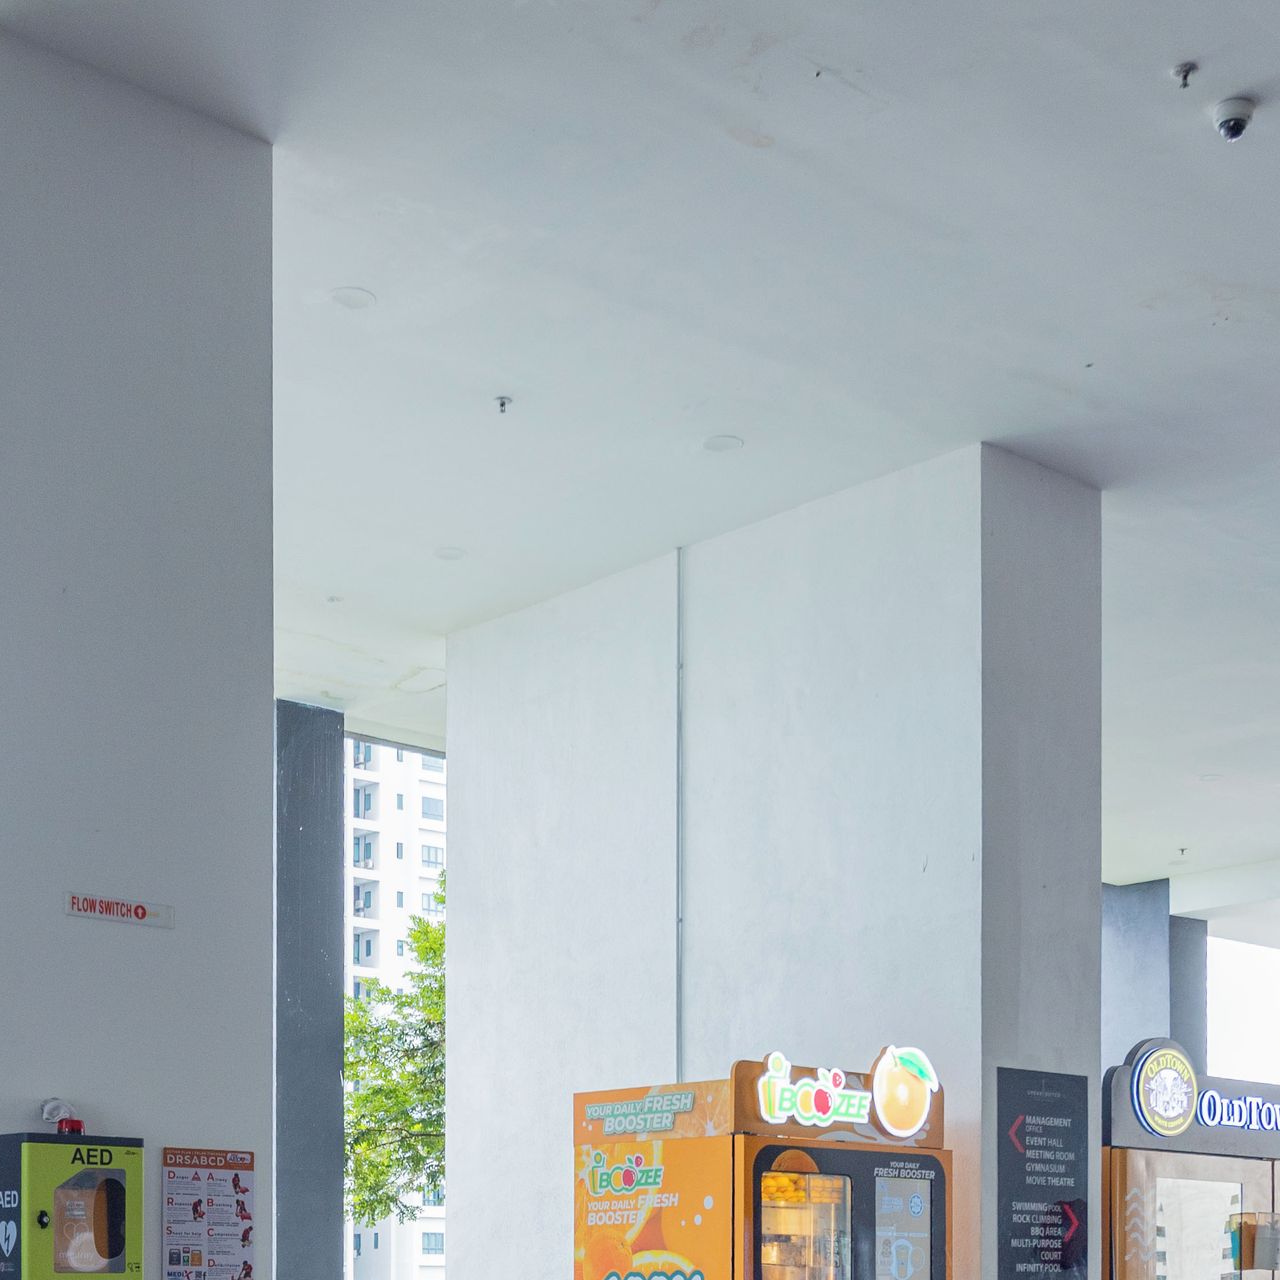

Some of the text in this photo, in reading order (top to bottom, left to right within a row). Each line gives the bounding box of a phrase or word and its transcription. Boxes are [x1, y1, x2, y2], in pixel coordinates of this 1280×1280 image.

[71, 896, 132, 918] FLOW SWITCH
[586, 1093, 694, 1117] YOUR DAILY FRESH
[605, 1113, 673, 1133] BOOSTER
[1025, 1115, 1072, 1127] MANAGEMENT
[1025, 1125, 1043, 1133] OFFICE
[1025, 1136, 1064, 1148] EVENT HALL
[71, 1148, 113, 1166] AED
[167, 1154, 225, 1167] DRSABCD
[1025, 1149, 1075, 1161] MEETING ROOM
[874, 1167, 936, 1180] FRESH BOOSTER
[1025, 1162, 1065, 1173] GYMNASIUM
[1025, 1176, 1075, 1187] MOVIE THEATRE
[587, 1193, 679, 1211] YOUR DAILY FRESH
[1012, 1201, 1062, 1212] SWIMMING POOL
[1012, 1214, 1062, 1224] ROCK CLIMBING
[1030, 1226, 1062, 1236] BBQ AREA
[1010, 1238, 1062, 1249] MULTI-PURPOSE
[1040, 1251, 1062, 1260] COURT
[1016, 1263, 1062, 1273] INFINITY POOL
